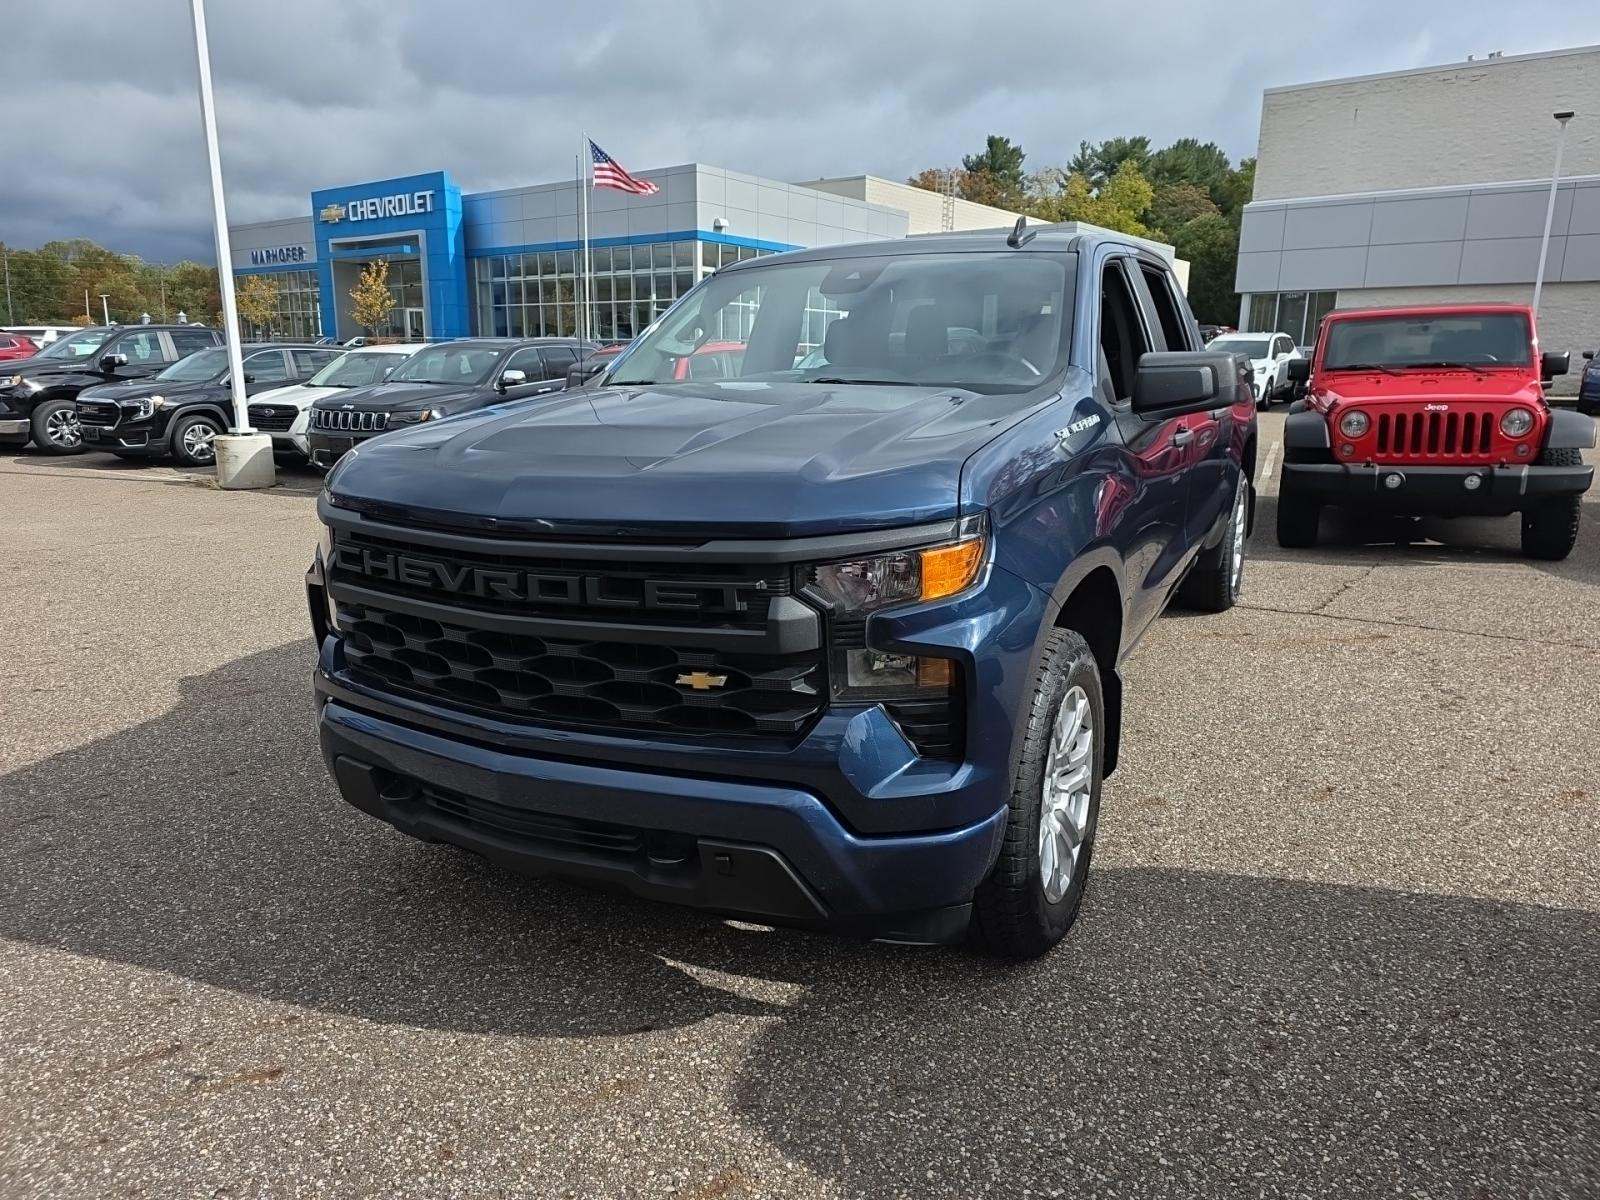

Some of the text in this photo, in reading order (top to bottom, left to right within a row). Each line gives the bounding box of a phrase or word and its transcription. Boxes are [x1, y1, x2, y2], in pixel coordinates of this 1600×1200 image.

[349, 190, 433, 222] CHEVROLET
[251, 246, 305, 265] MARHOFER
[1424, 402, 1449, 411] Jeep
[335, 544, 767, 611] CHEVROLET
